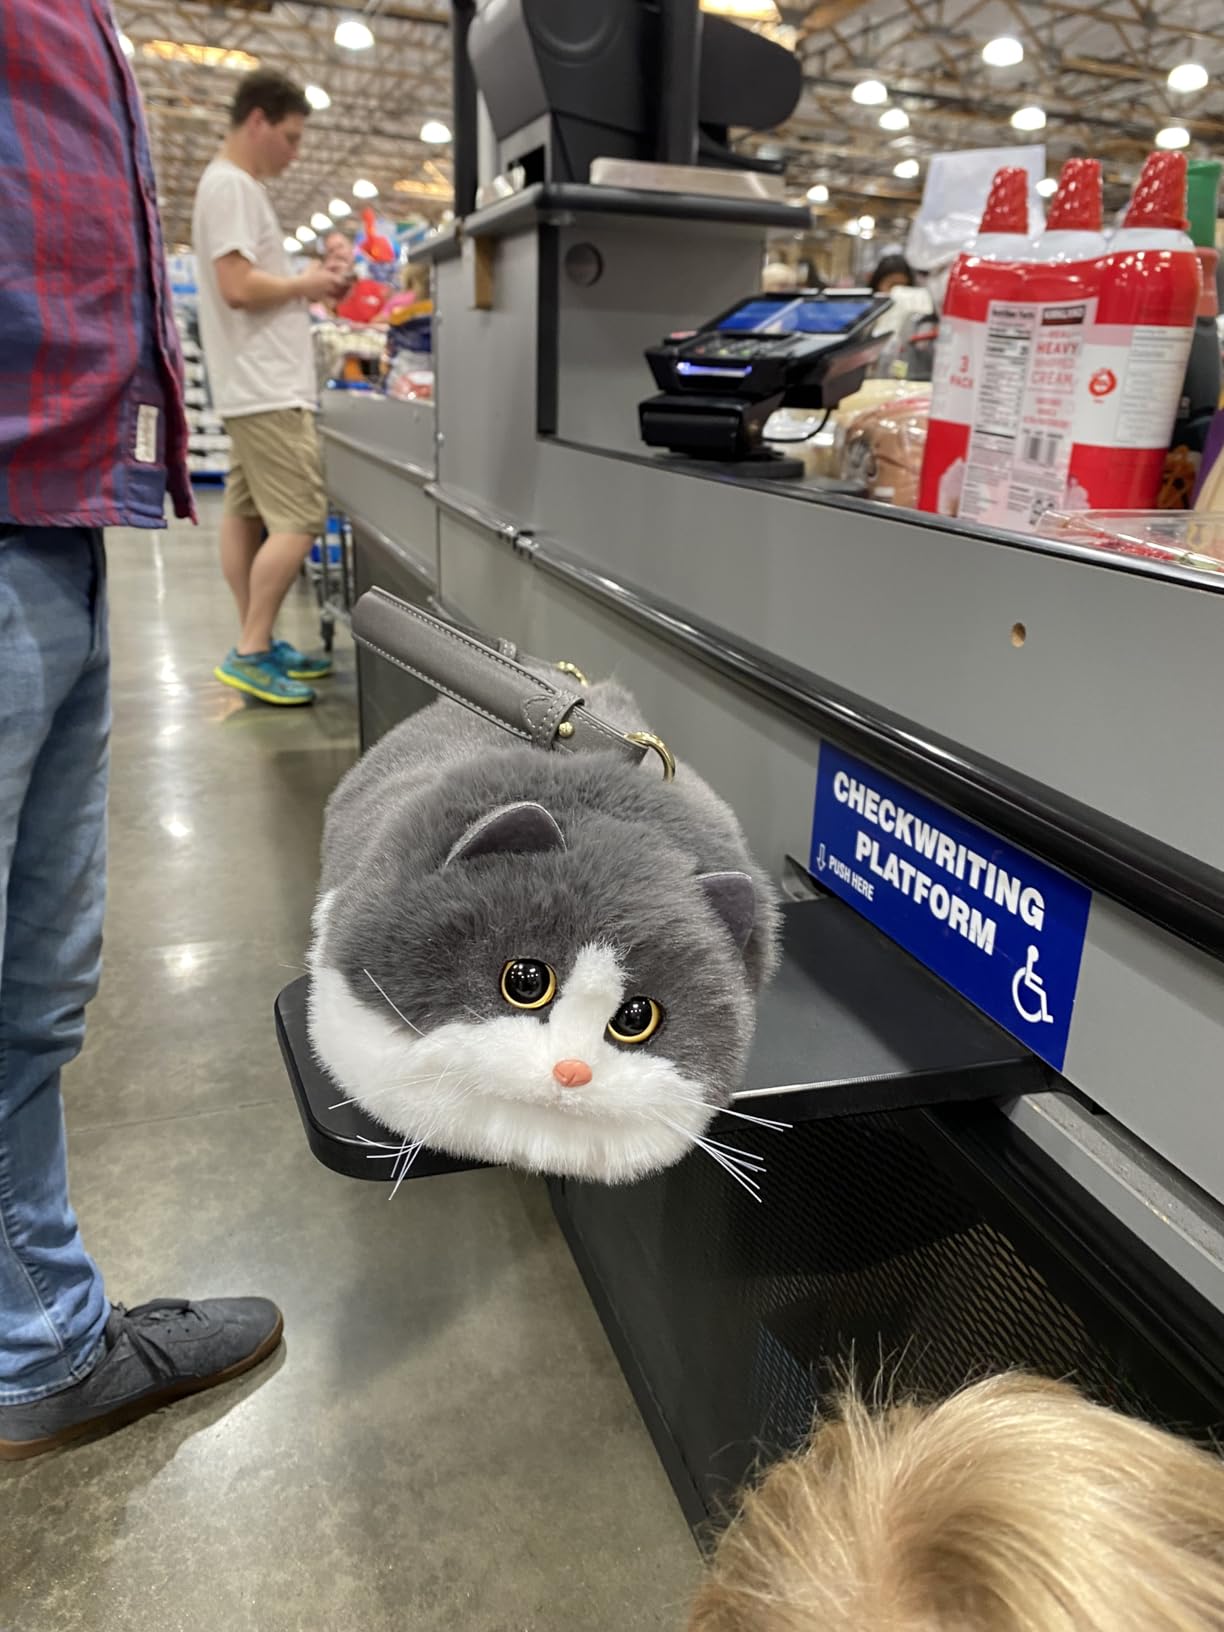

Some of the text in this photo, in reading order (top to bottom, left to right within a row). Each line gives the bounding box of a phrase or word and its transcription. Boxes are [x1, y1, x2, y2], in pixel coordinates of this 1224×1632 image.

[1036, 342, 1079, 354] HEAVY
[1032, 370, 1073, 384] CREAM
[833, 771, 1045, 931] CHECKWRITING
[829, 854, 875, 901] PUSH HERE
[855, 831, 997, 955] PLATFORM
